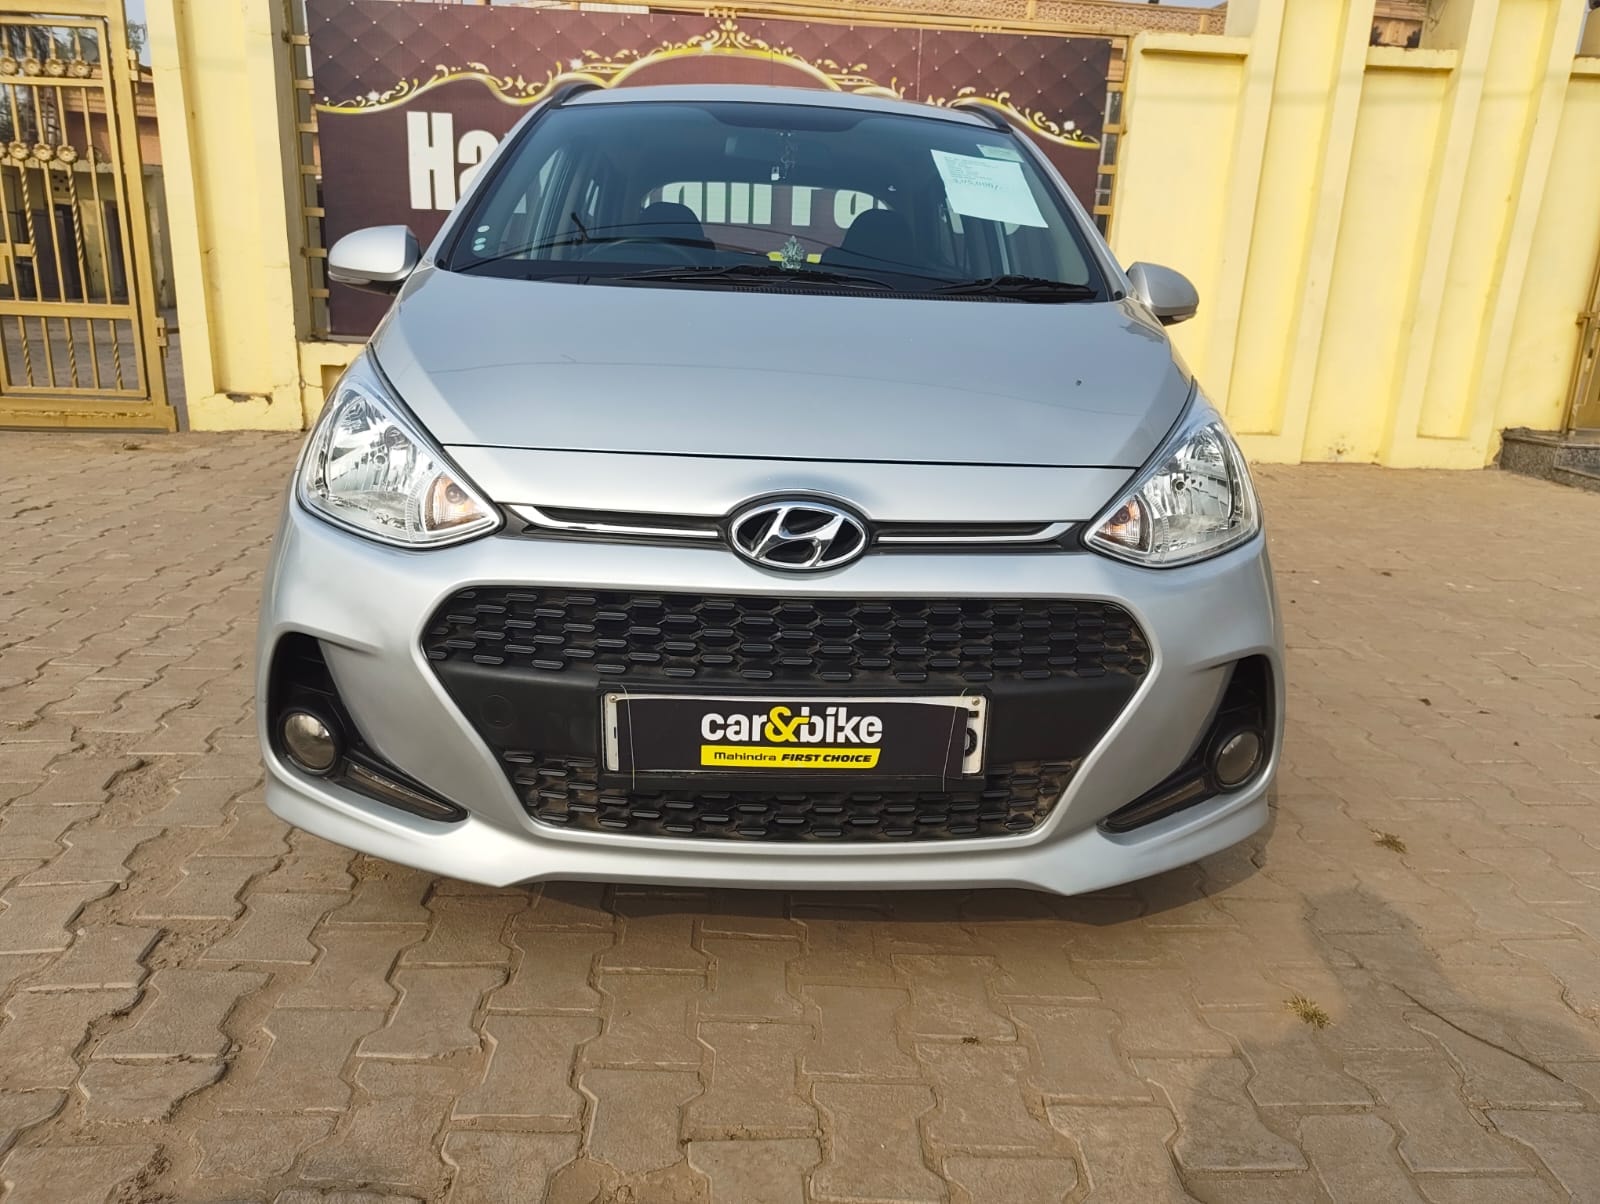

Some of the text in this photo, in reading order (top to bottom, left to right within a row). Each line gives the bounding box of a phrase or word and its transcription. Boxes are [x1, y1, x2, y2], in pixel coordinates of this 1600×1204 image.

[406, 111, 501, 211] Ha
[701, 706, 883, 744] car&bike
[714, 751, 872, 763] Mahindra FIRST CHOICE
